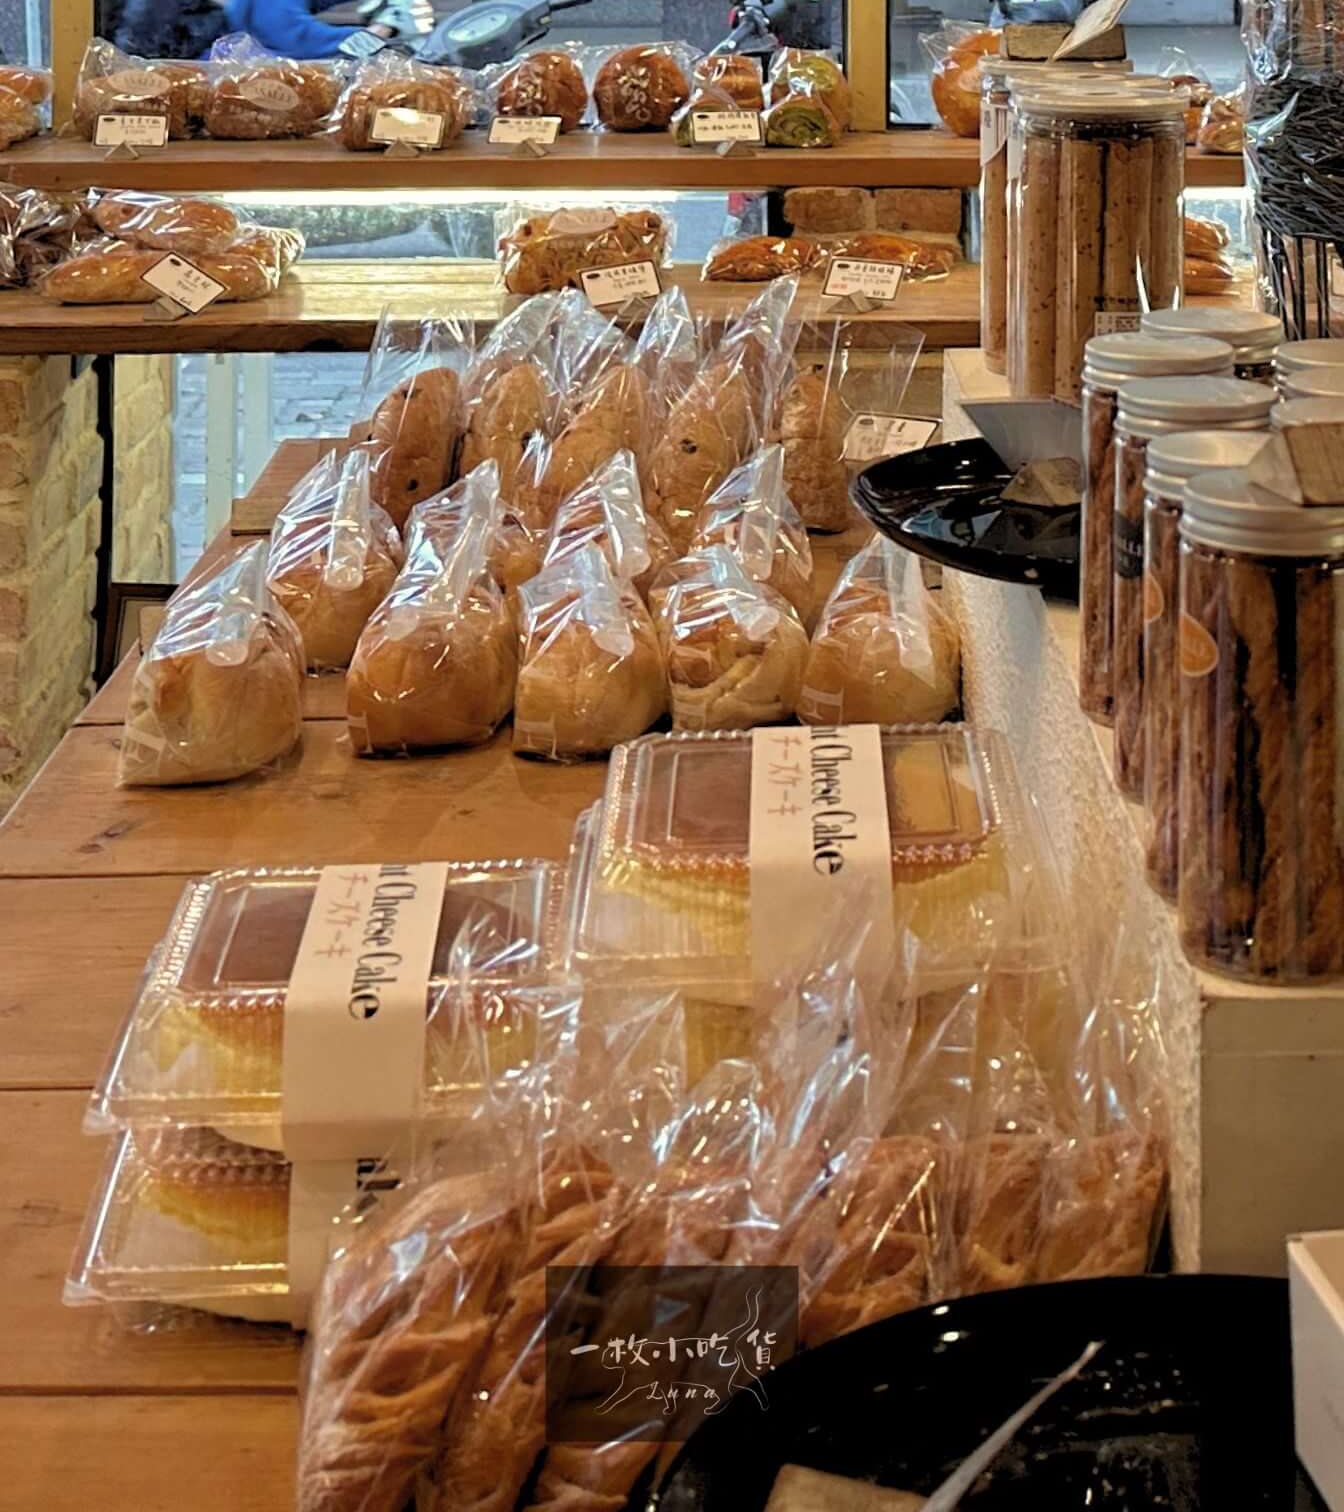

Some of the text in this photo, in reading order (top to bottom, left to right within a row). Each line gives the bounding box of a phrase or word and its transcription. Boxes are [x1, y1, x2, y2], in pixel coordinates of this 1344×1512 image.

[810, 745, 852, 804] Cheese
[812, 811, 857, 875] Cake
[362, 881, 417, 947] Cheese
[348, 952, 403, 1021] Cake
